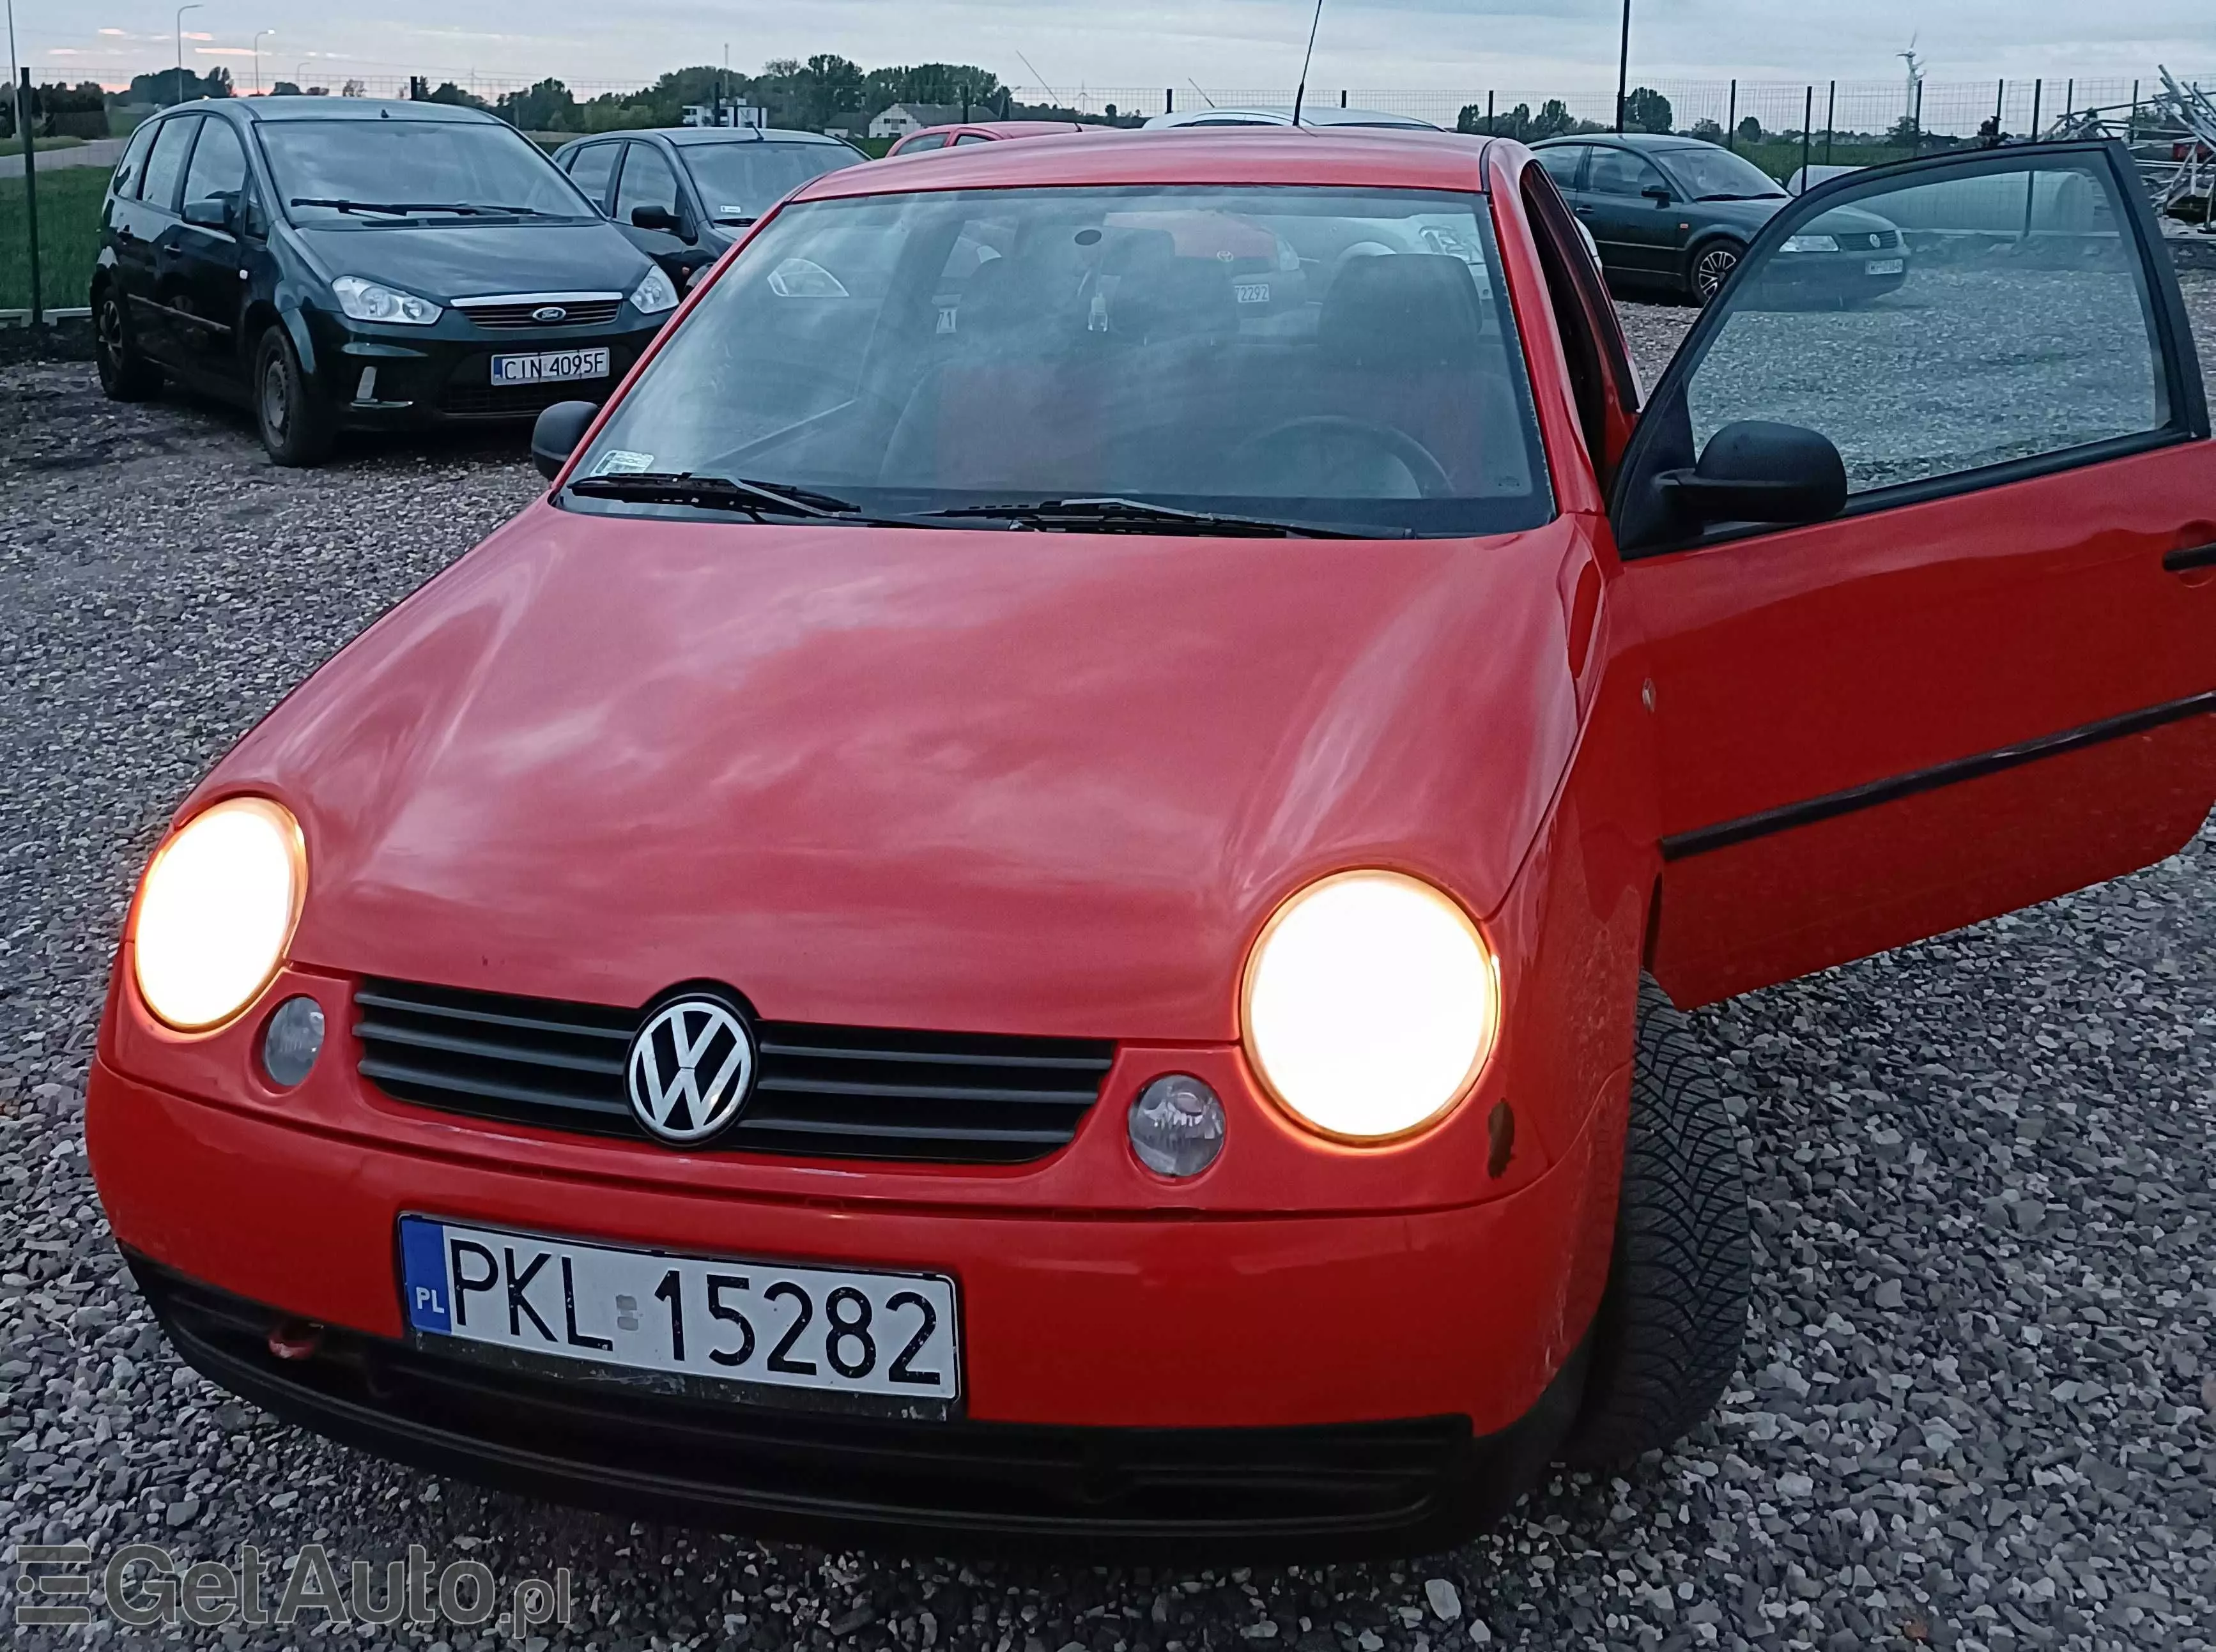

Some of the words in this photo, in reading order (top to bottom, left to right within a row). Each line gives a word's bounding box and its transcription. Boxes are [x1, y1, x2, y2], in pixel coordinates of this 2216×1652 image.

[504, 359, 542, 380] CIN
[549, 351, 605, 376] 4095F
[415, 1286, 445, 1314] PL
[450, 1238, 613, 1352] PKL
[654, 1270, 941, 1385] 15282
